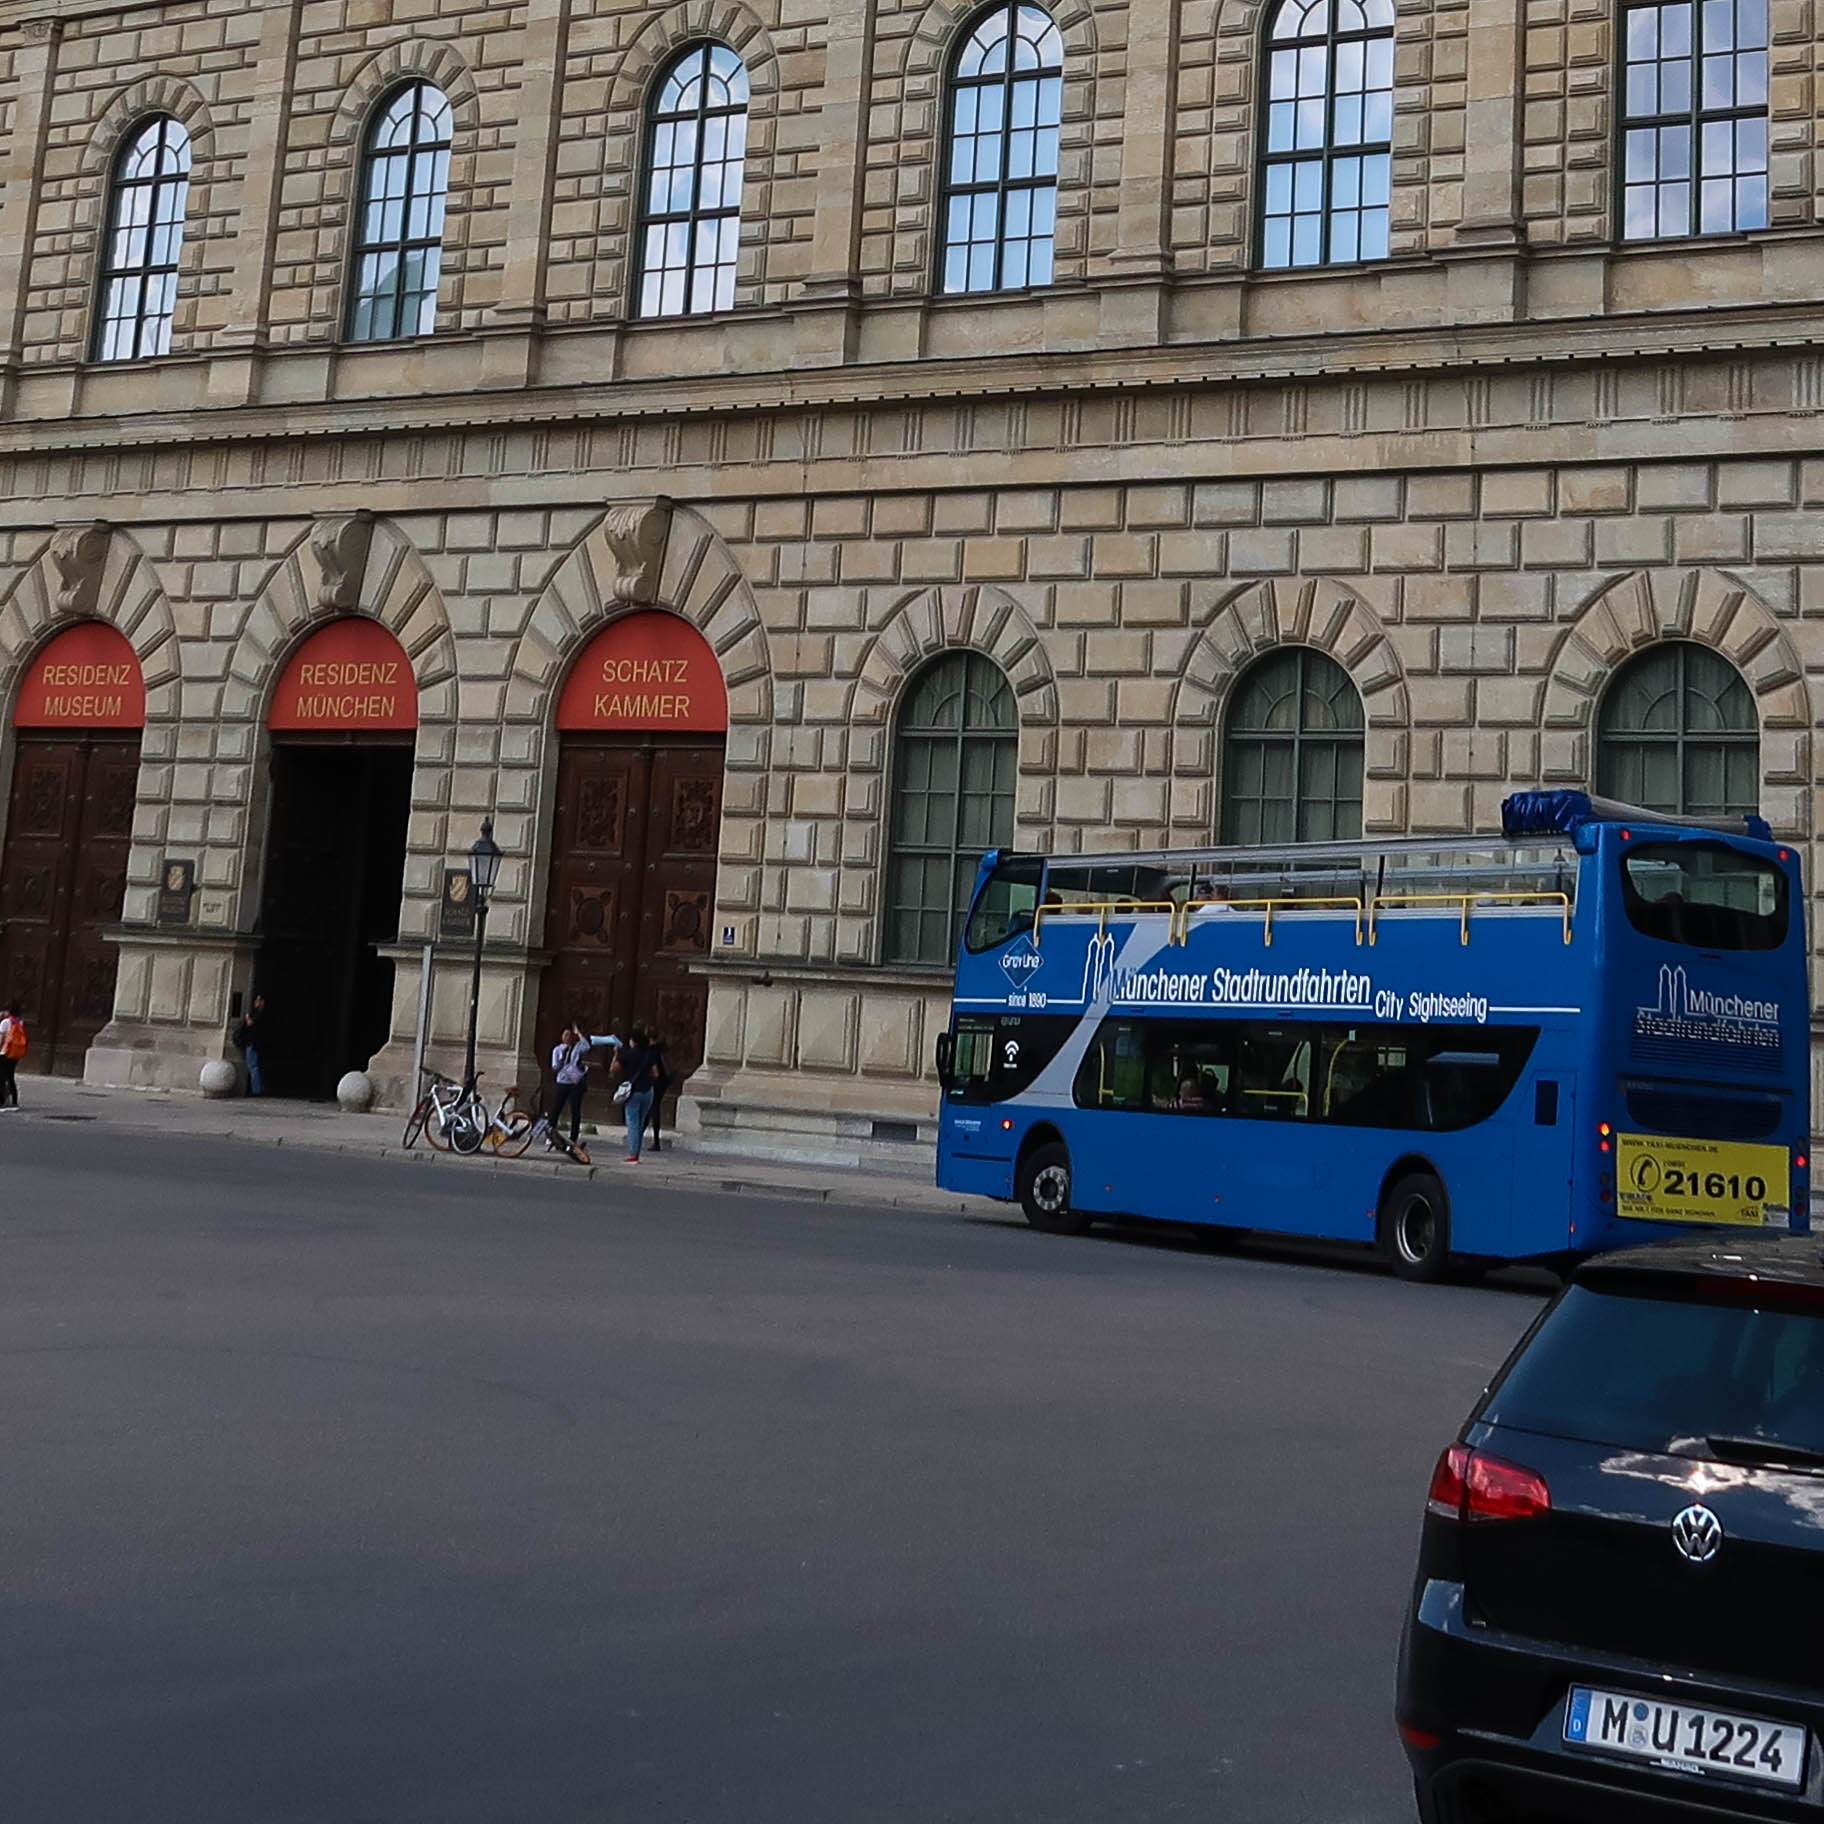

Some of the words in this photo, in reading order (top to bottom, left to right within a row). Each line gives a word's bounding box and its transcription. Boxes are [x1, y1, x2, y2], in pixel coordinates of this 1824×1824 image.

[43, 664, 131, 686] RESIDENZ
[300, 662, 398, 686] RESIDENZ
[602, 659, 689, 683] SCHATZ
[44, 695, 122, 717] MUSEUM
[296, 693, 395, 718] MÜNCHEN
[594, 693, 690, 719] KAMMER
[1212, 967, 1371, 1004] Stadtrundfahrten
[1376, 989, 1404, 1021] City
[1408, 992, 1488, 1024] Sightseeing
[1690, 989, 1780, 1020] Münchener
[1663, 1169, 1766, 1201] 21610
[1600, 1697, 1630, 1744] M
[1651, 1707, 1679, 1753] U
[1683, 1714, 1783, 1774] 1224
